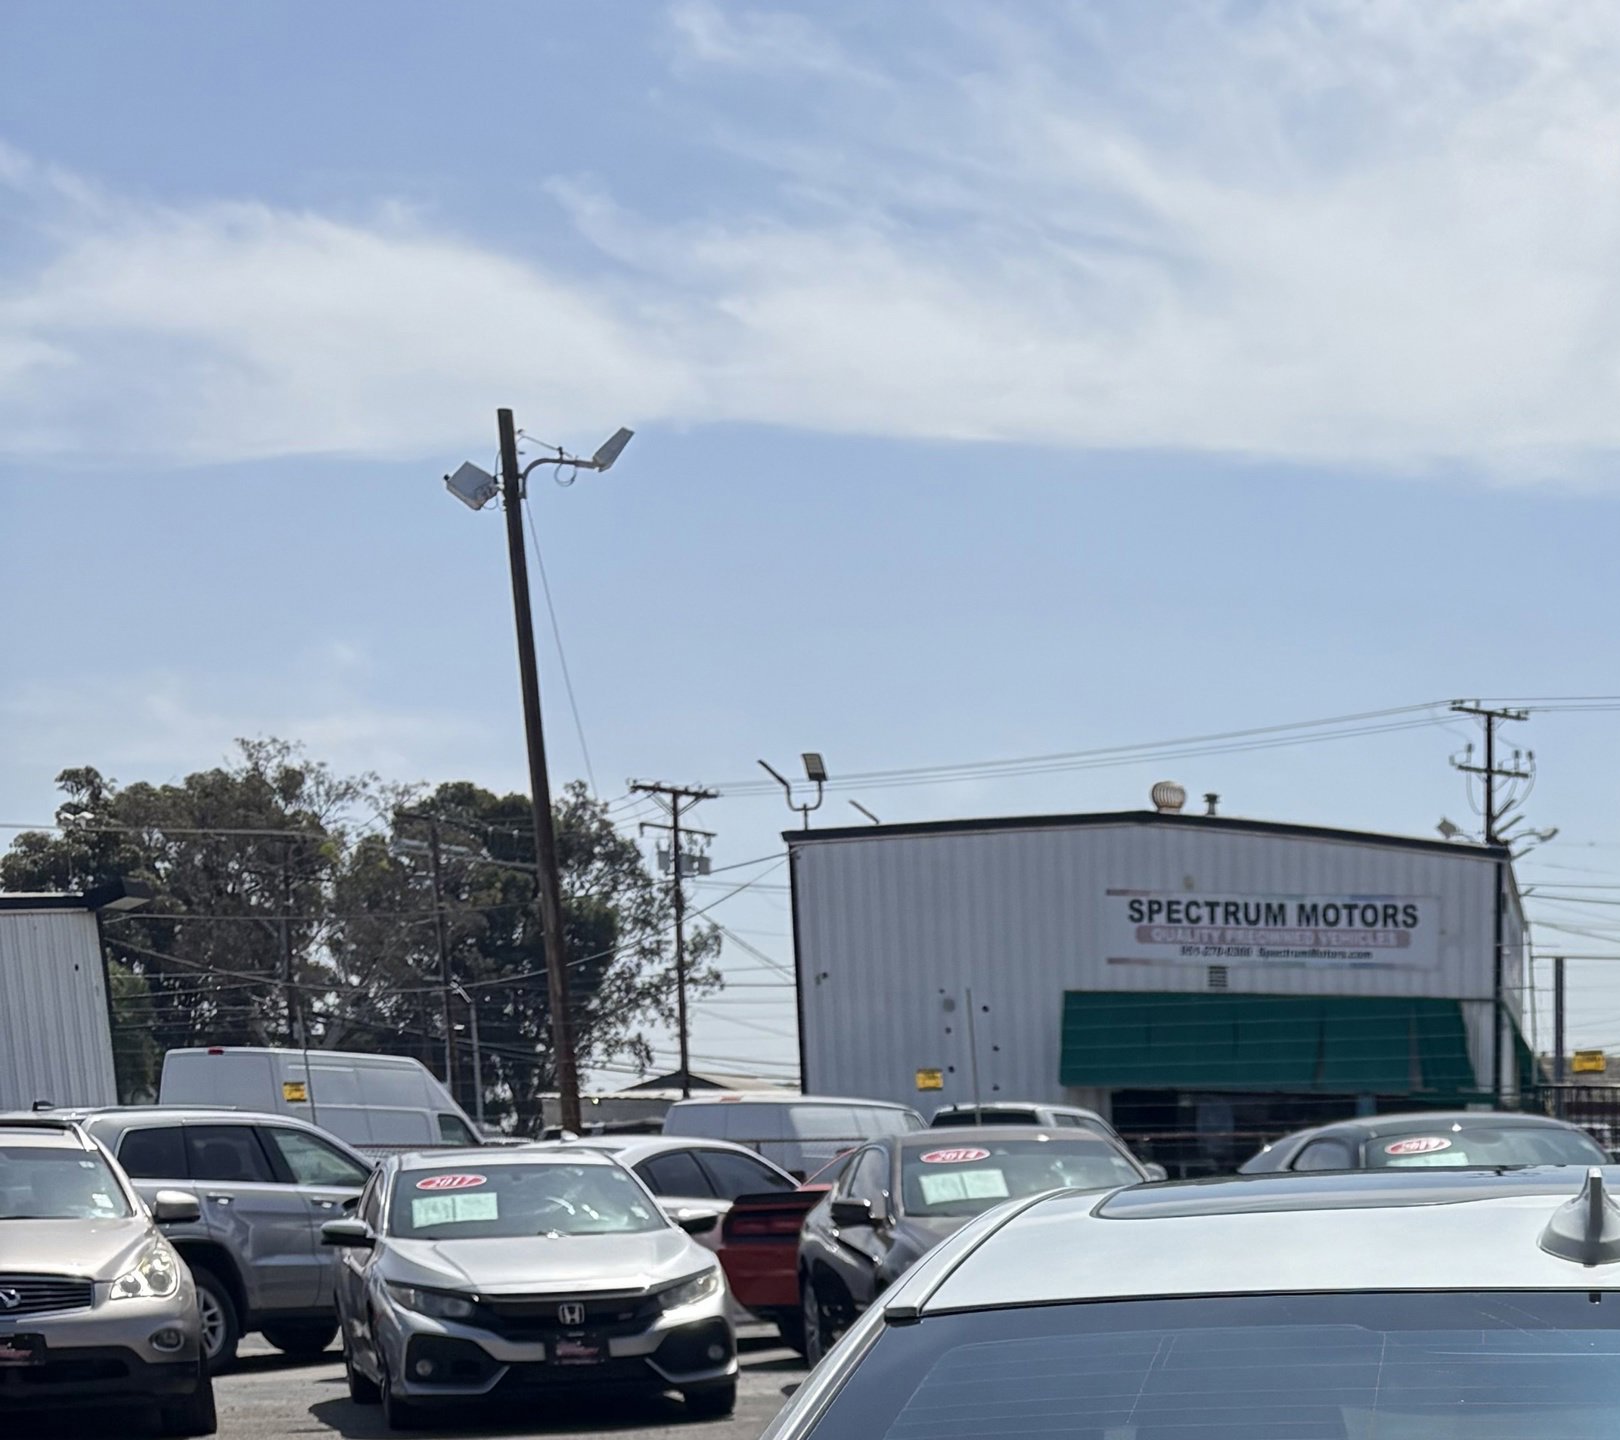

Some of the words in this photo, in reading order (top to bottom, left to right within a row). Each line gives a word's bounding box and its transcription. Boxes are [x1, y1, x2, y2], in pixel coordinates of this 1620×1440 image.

[1128, 899, 1287, 926] SPECTRUM
[1297, 902, 1419, 928] MOTORS
[1151, 927, 1219, 943] QUALITY
[1319, 929, 1397, 947] VEHICLES
